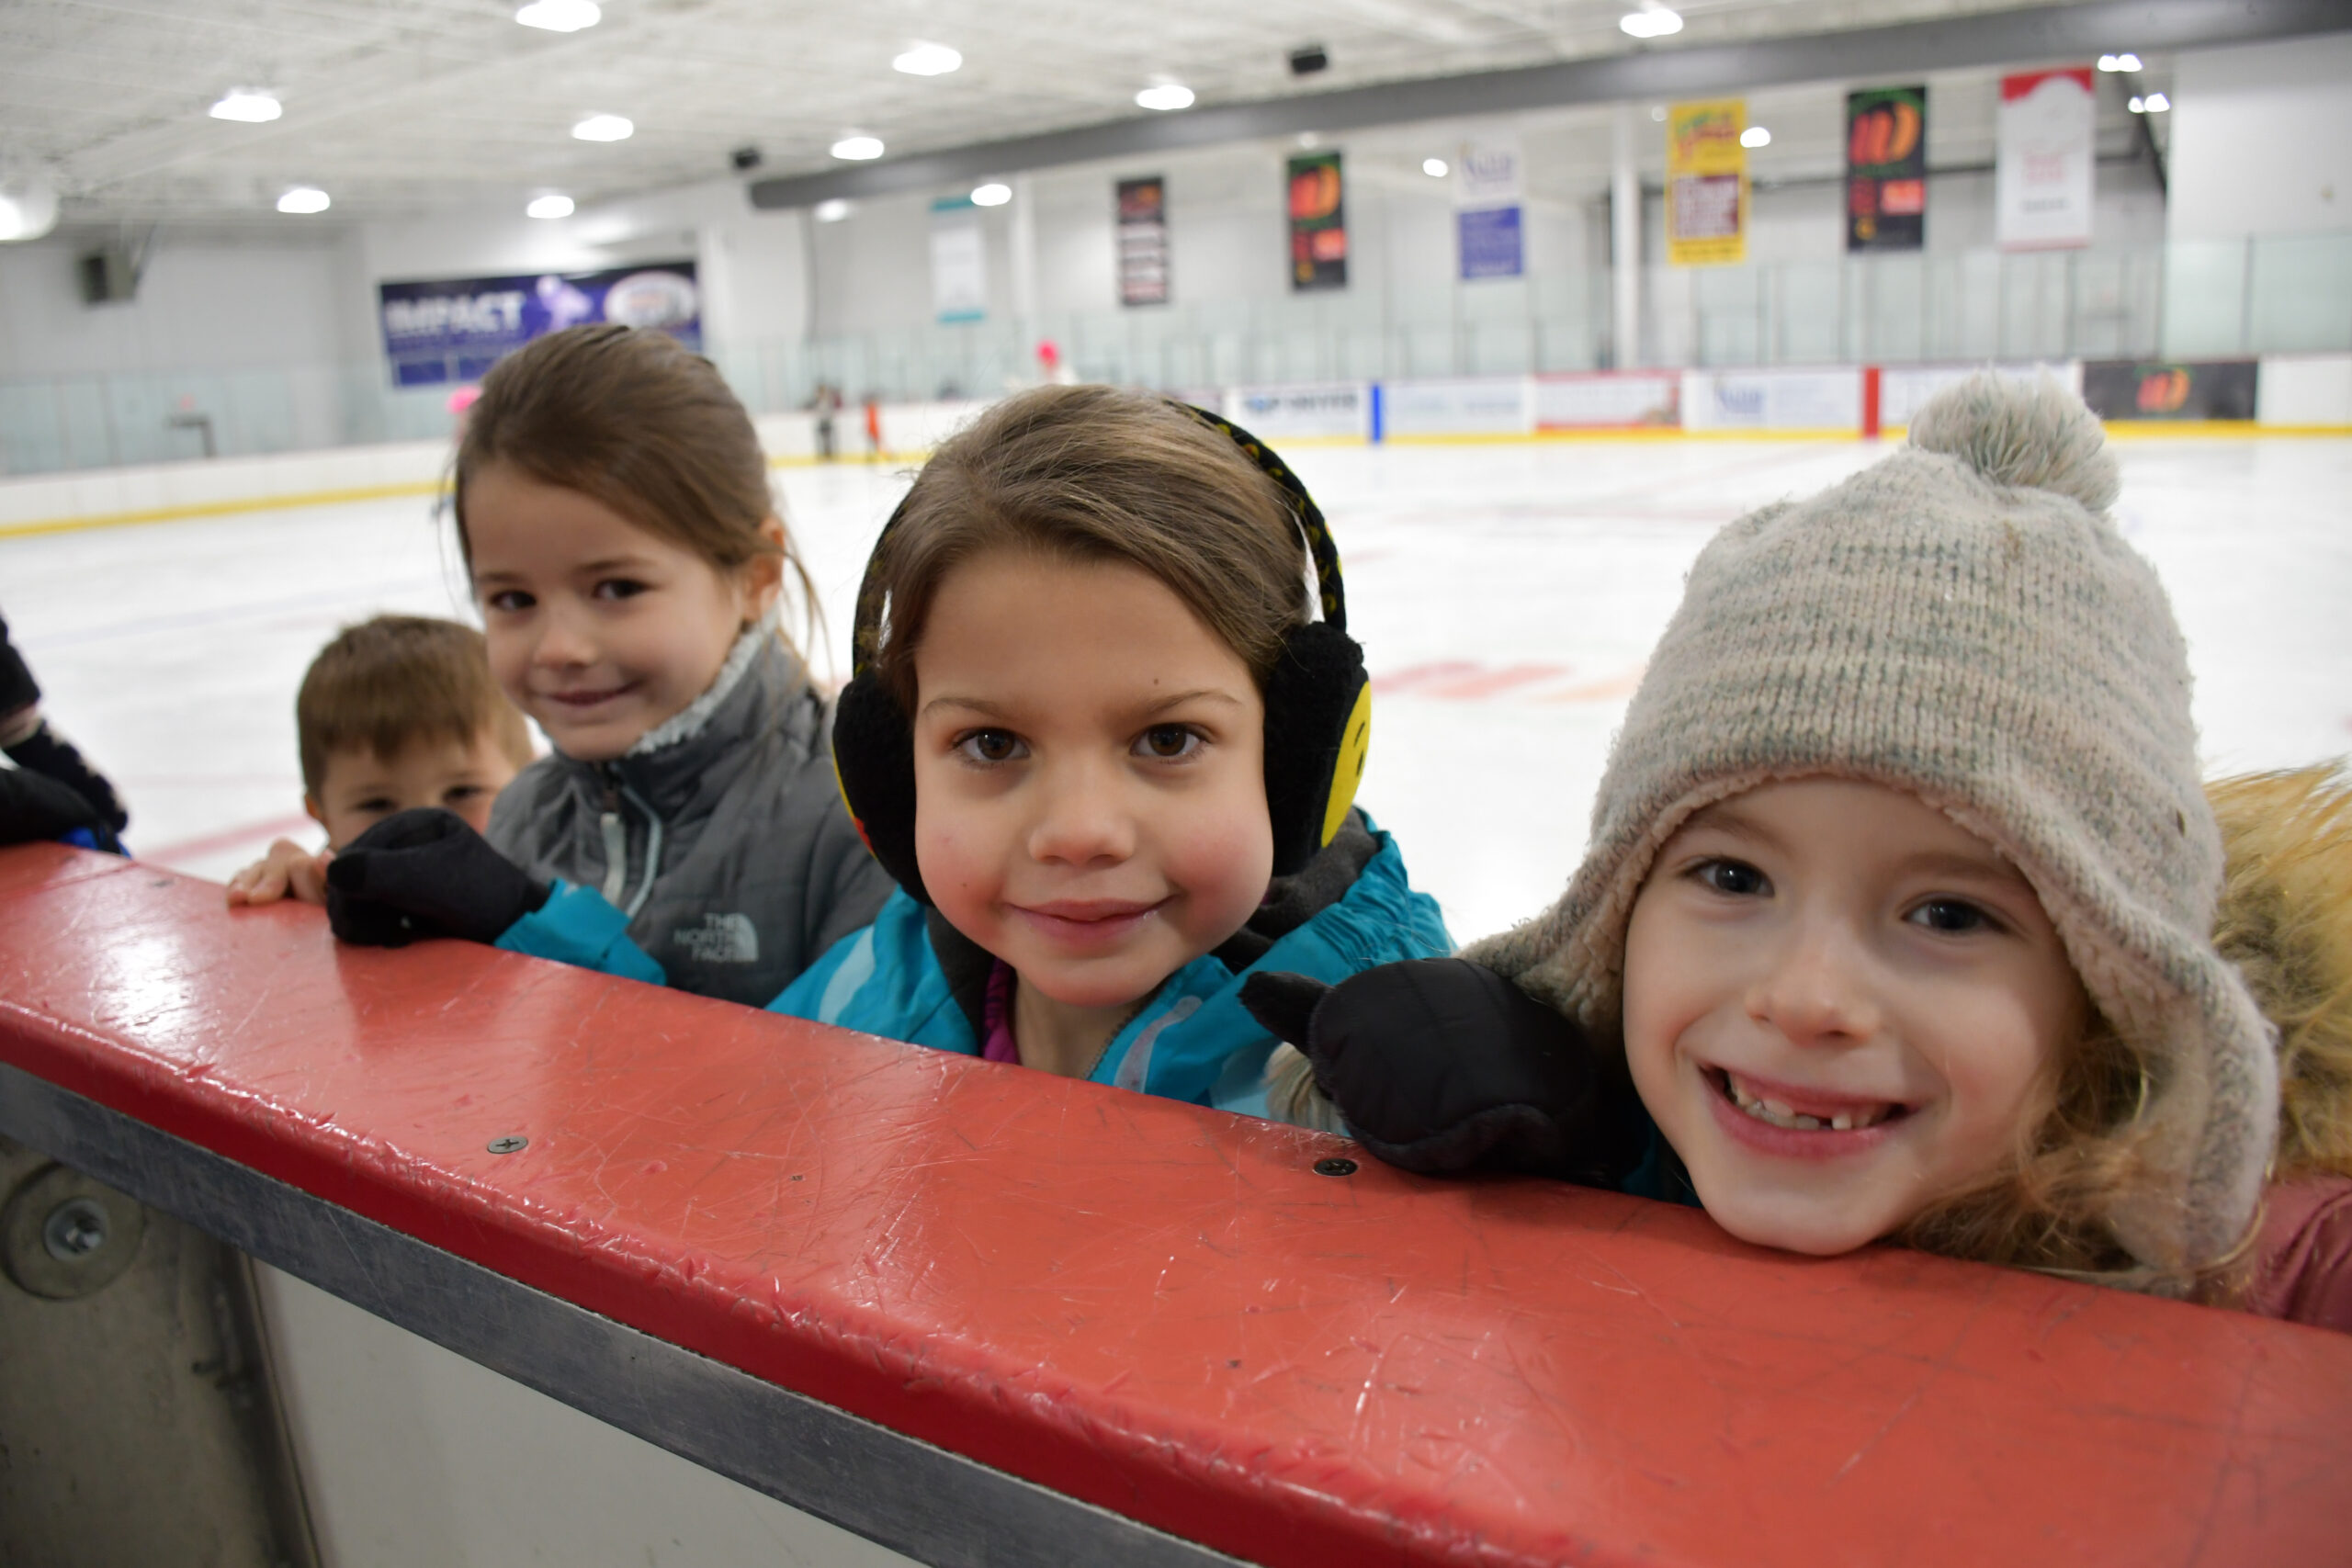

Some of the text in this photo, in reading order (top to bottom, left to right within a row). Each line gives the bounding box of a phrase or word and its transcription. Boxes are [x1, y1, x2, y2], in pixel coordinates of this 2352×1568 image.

[385, 290, 526, 336] IMPACT
[705, 912, 738, 930] THE
[673, 929, 736, 945] NORTH
